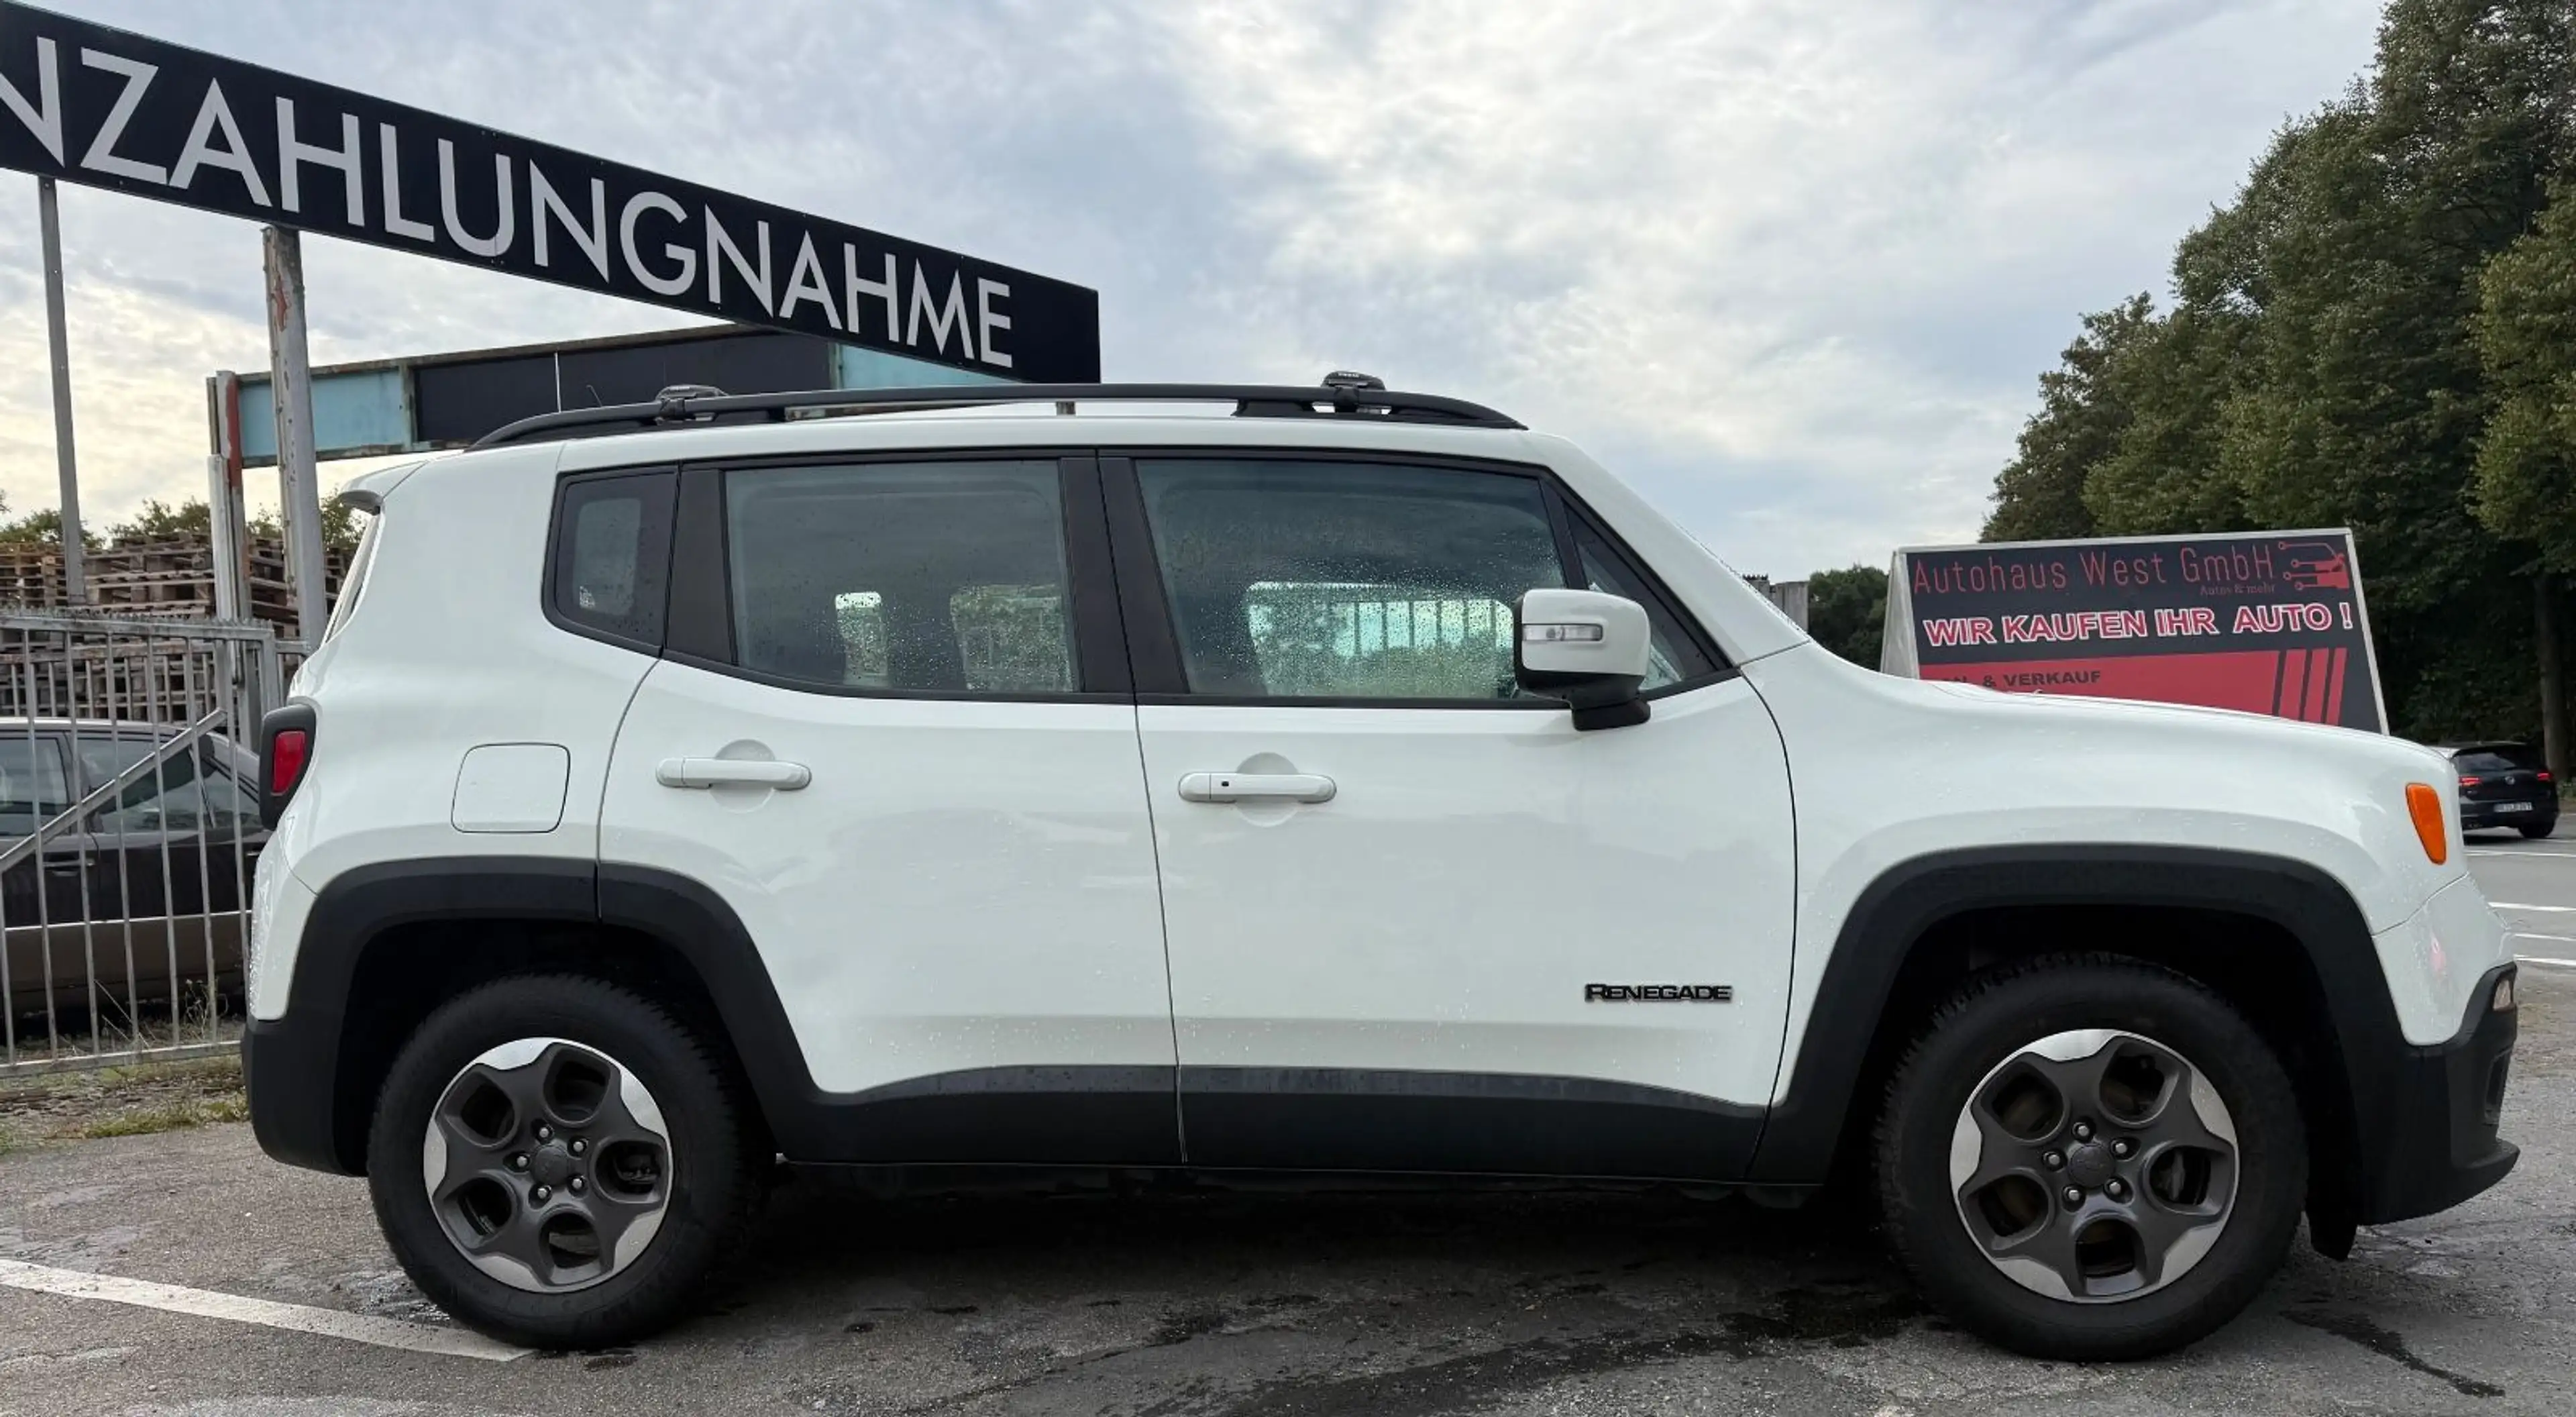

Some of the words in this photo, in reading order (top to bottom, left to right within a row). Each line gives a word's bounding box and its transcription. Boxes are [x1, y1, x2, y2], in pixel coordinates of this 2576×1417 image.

[1913, 556, 2067, 594] Autohaus
[2080, 551, 2167, 586] West
[2180, 544, 2274, 582] GmbH
[1923, 617, 1997, 647] WIR
[2001, 610, 2148, 643] KAUFEN
[2154, 607, 2220, 637] IHR
[2233, 602, 2332, 634] AUTO
[2339, 602, 2353, 630] !
[2002, 670, 2101, 687] VERKAUF
[1584, 983, 1733, 1002] RENEGADE
